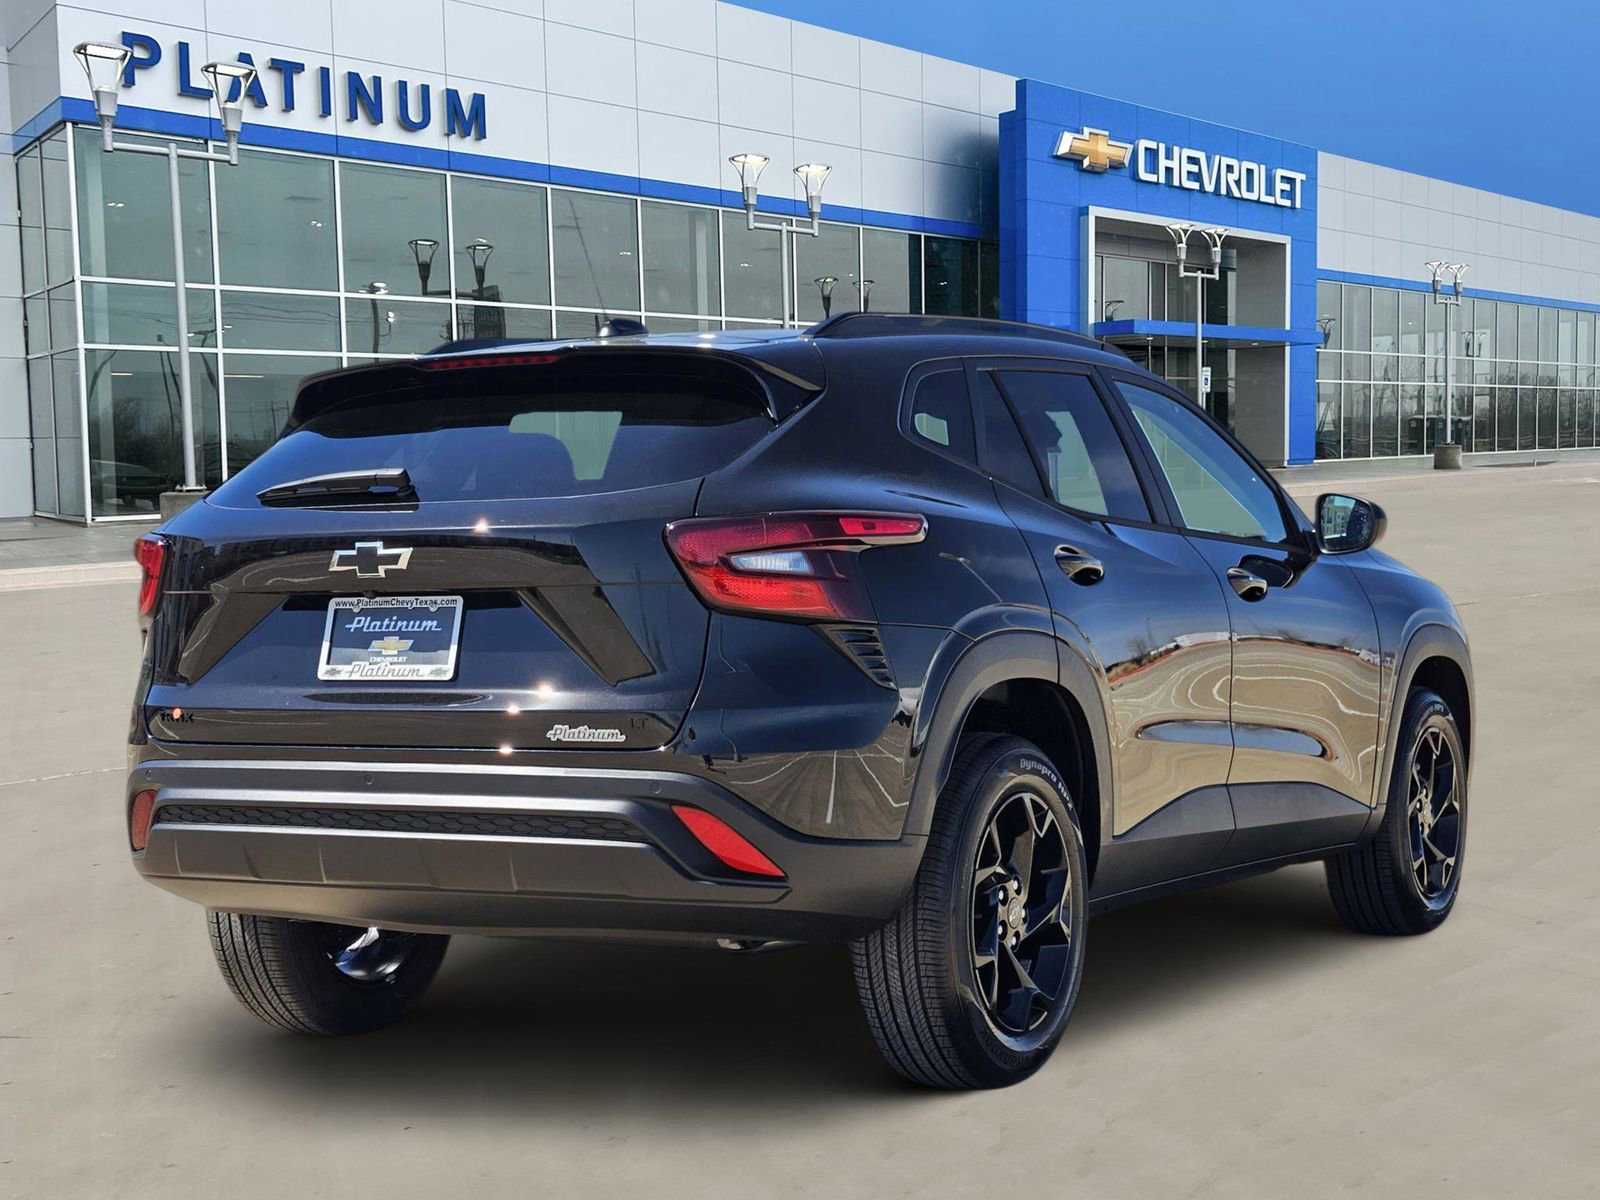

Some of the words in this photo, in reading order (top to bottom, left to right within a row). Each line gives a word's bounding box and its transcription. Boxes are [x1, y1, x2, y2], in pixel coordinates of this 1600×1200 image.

[121, 31, 487, 140] PLATINUM
[1135, 138, 1306, 209] CHEVROLET
[334, 598, 458, 609] www.PlatinumChevyTexas.com
[345, 616, 442, 632] Platinum
[344, 663, 425, 678] Platinum
[547, 725, 626, 741] Platinum
